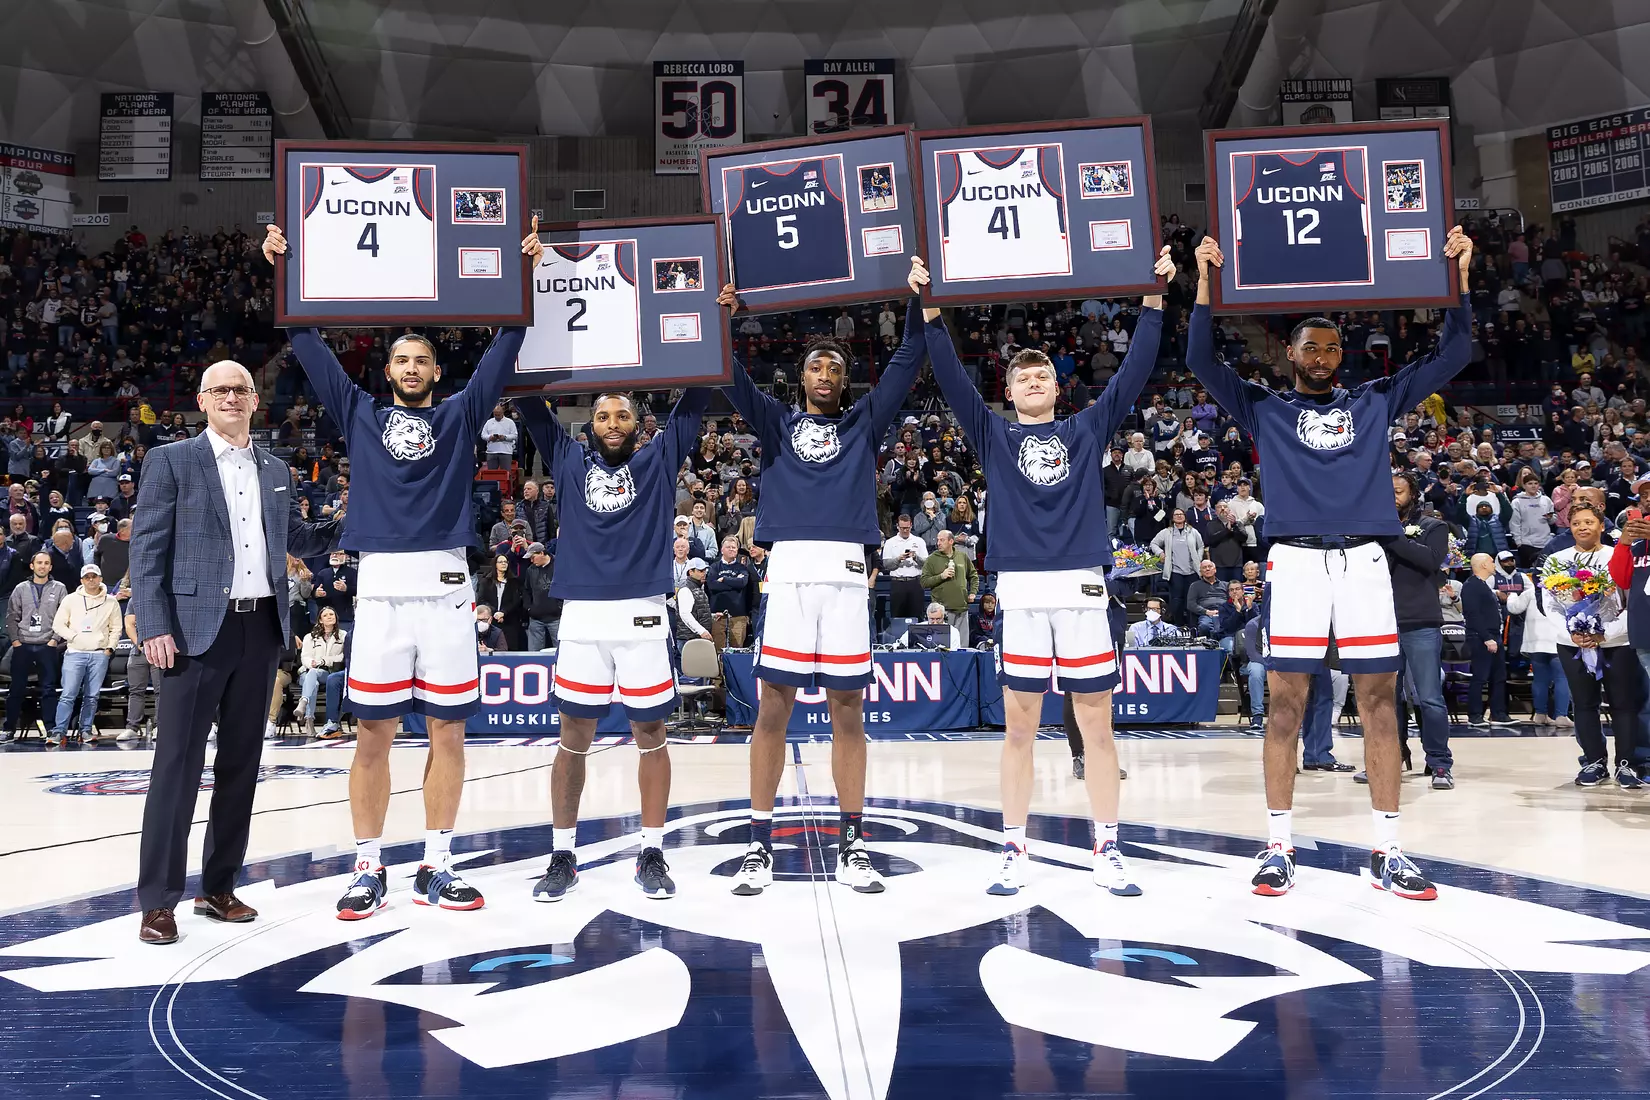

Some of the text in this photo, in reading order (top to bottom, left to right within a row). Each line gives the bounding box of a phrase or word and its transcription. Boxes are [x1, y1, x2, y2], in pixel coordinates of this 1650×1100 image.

[663, 64, 734, 74] REBECCA LOBO
[824, 62, 875, 72] RAY ALLEN
[1281, 80, 1351, 92] GENO AURIEMMA
[662, 81, 736, 139] 50
[813, 79, 888, 134] 34
[1552, 126, 1579, 138] BIG
[1589, 114, 1634, 130] EAST
[1552, 131, 1613, 148] REGULAR
[1614, 136, 1637, 152] 1995
[1553, 149, 1575, 163] 1990
[1584, 143, 1606, 158] 1994
[10, 159, 43, 170] FOUR
[1584, 161, 1608, 176] 2005
[1615, 155, 1640, 170] 2006
[1554, 167, 1578, 181] 2003
[962, 183, 1041, 201] UCONN
[1257, 185, 1343, 204] UCONN
[1560, 190, 1641, 210] CONNECTICUT
[326, 199, 410, 216] UCONN
[746, 191, 825, 214] UCONN
[1460, 200, 1478, 208] 212
[988, 205, 1020, 239] 41
[1282, 208, 1321, 245] 12
[357, 222, 379, 257] 4
[776, 214, 799, 249] 5
[537, 276, 615, 293] UCONN
[566, 298, 588, 331] 2
[1530, 428, 1542, 438] 1
[807, 712, 892, 724] HUIES
